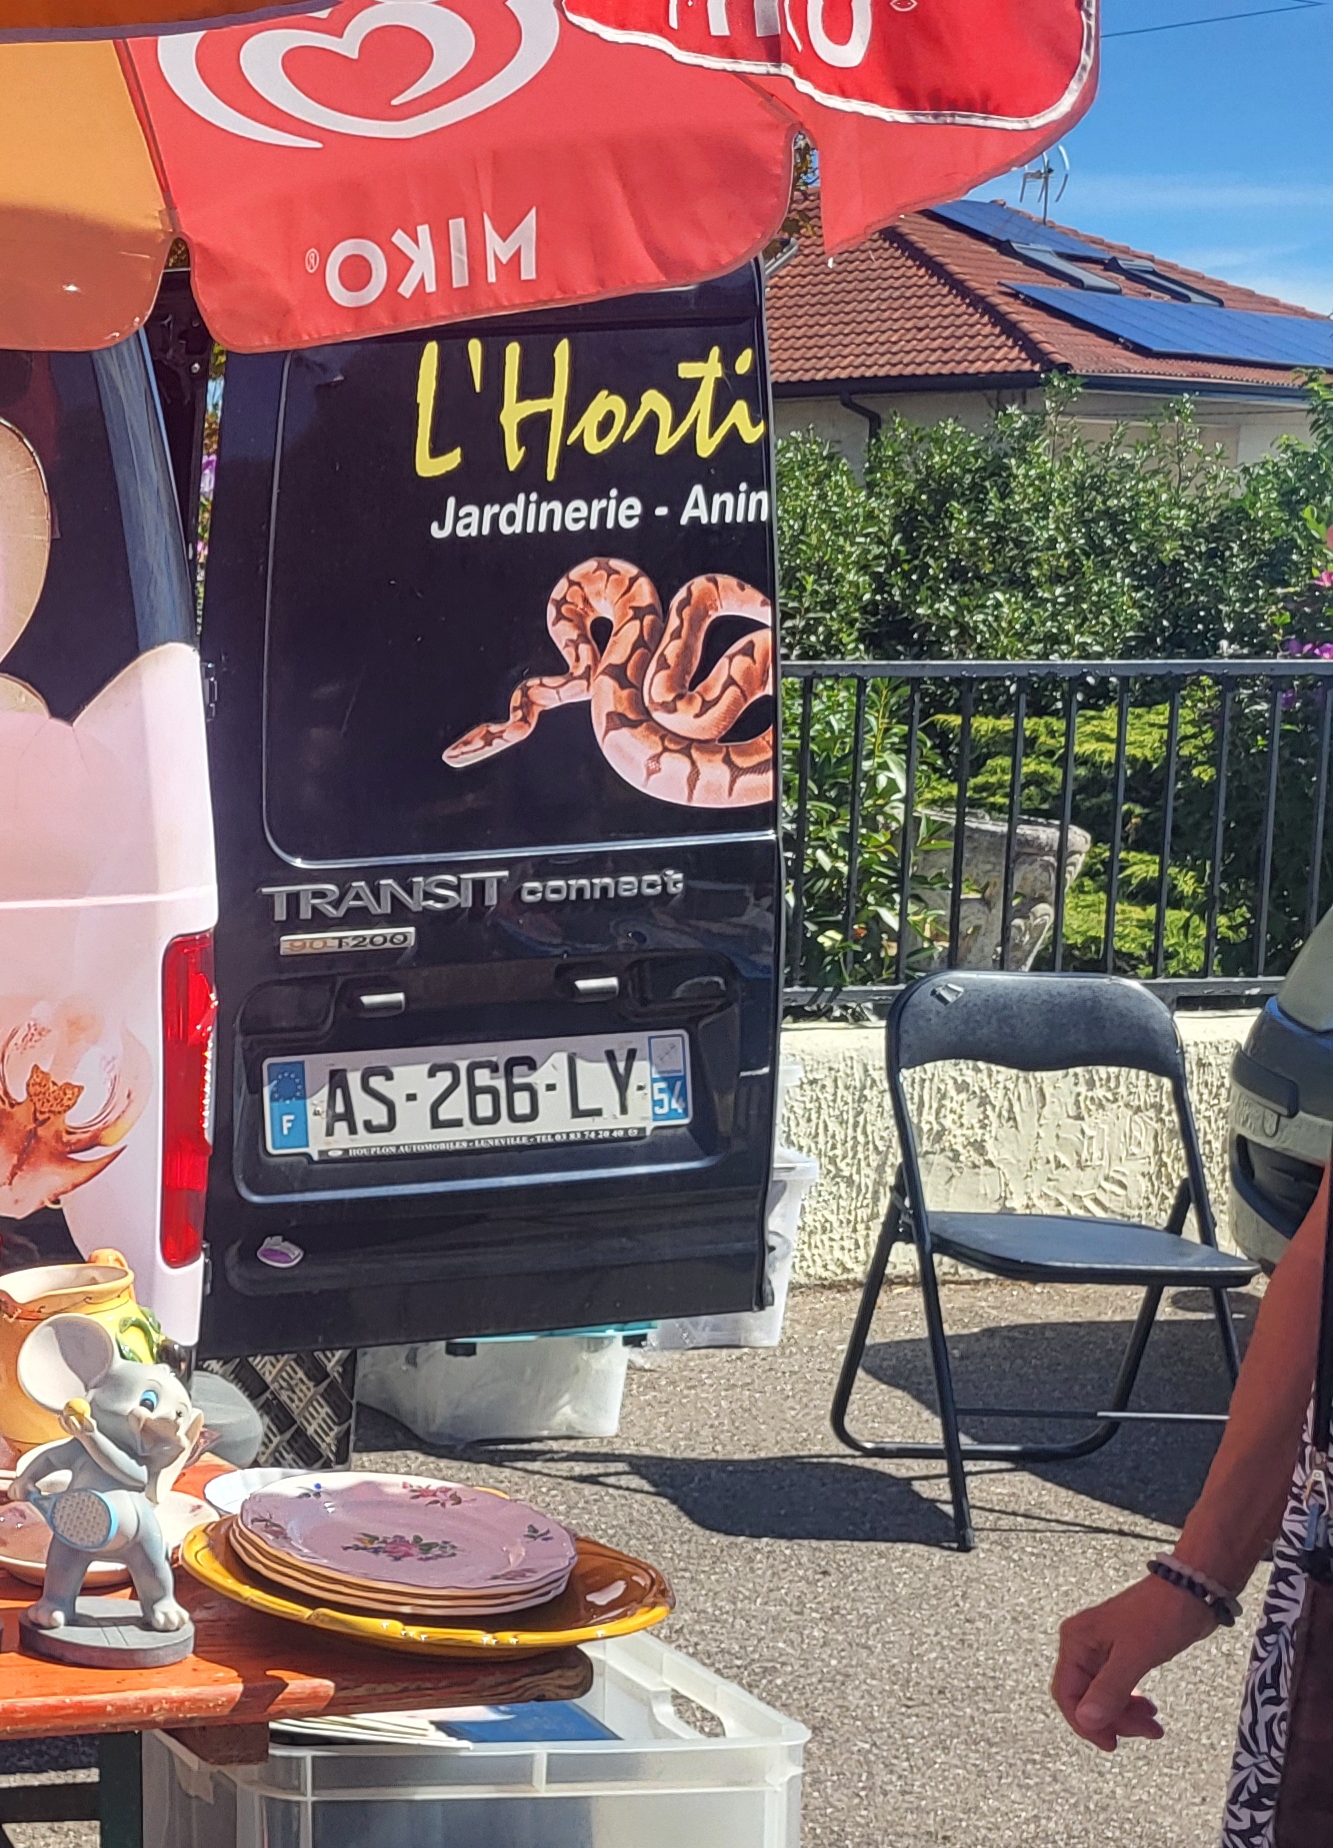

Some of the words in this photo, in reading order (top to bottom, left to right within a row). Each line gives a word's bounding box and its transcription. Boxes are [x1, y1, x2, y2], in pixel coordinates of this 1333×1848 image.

[430, 487, 642, 539] Jardinerie
[260, 870, 511, 922] TRANSIT
[520, 869, 685, 904] connect
[652, 1080, 687, 1117] 54
[279, 1113, 297, 1138] F
